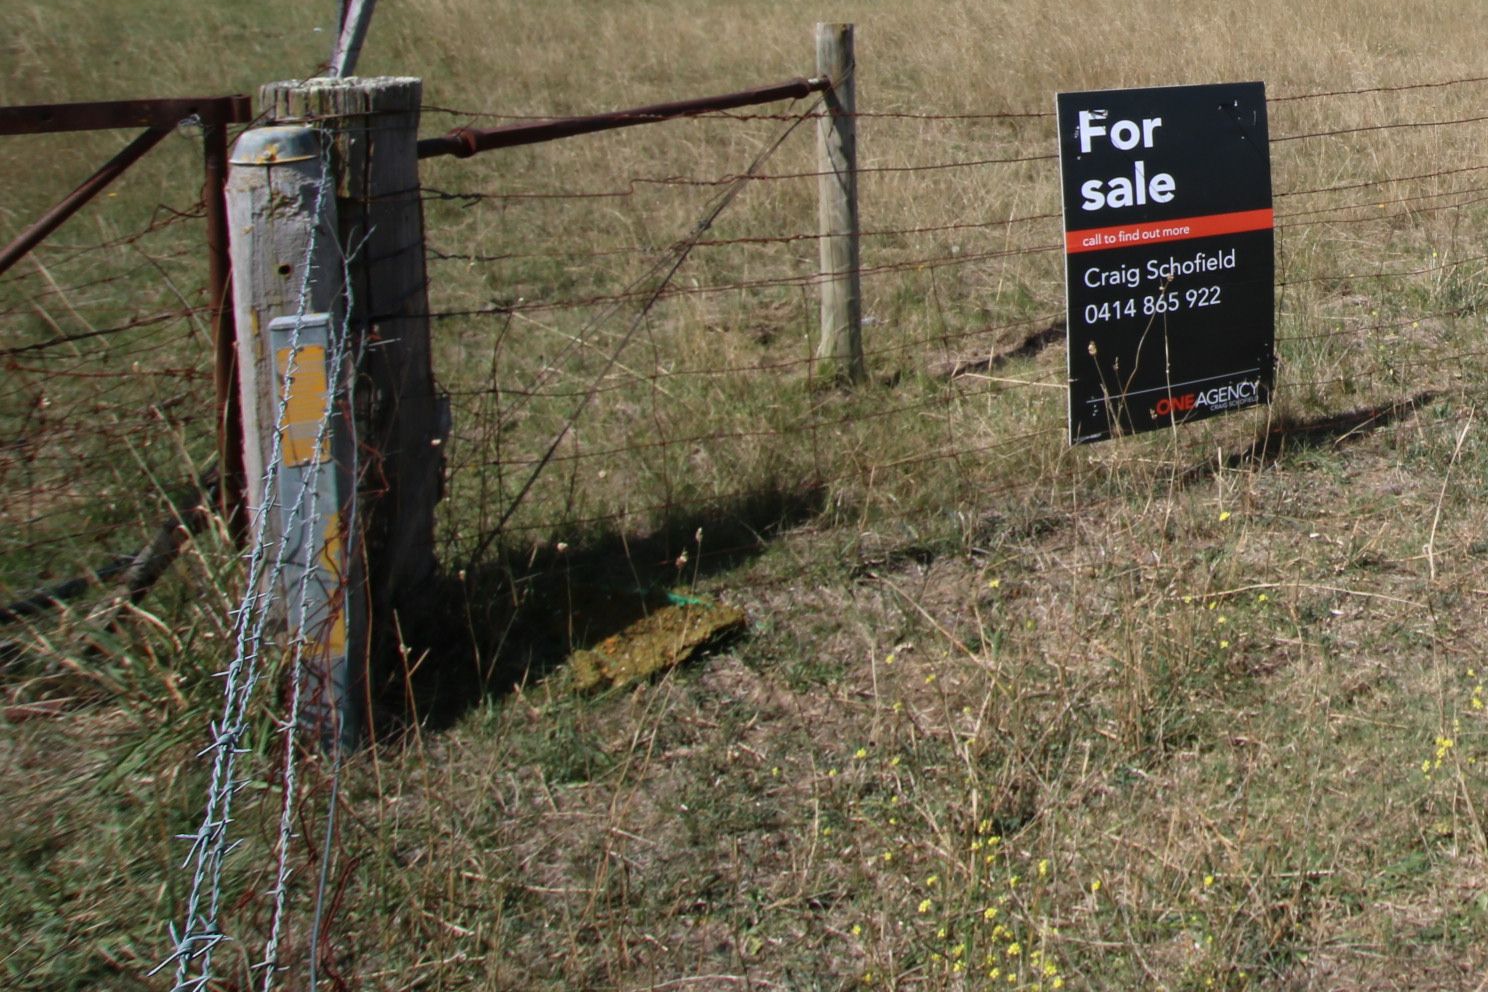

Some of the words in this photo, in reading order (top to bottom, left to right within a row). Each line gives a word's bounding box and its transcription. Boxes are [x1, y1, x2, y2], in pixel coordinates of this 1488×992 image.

[1078, 109, 1162, 153] For
[1081, 160, 1176, 211] sale
[1082, 234, 1102, 247] call
[1104, 234, 1117, 245] to
[1119, 228, 1140, 242] find
[1142, 228, 1161, 240] out
[1162, 225, 1190, 236] more
[1084, 263, 1141, 288] Craig
[1146, 248, 1236, 280] Schofield
[1085, 298, 1137, 325] 0414
[1143, 292, 1179, 316] 865
[1185, 285, 1222, 309] 922
